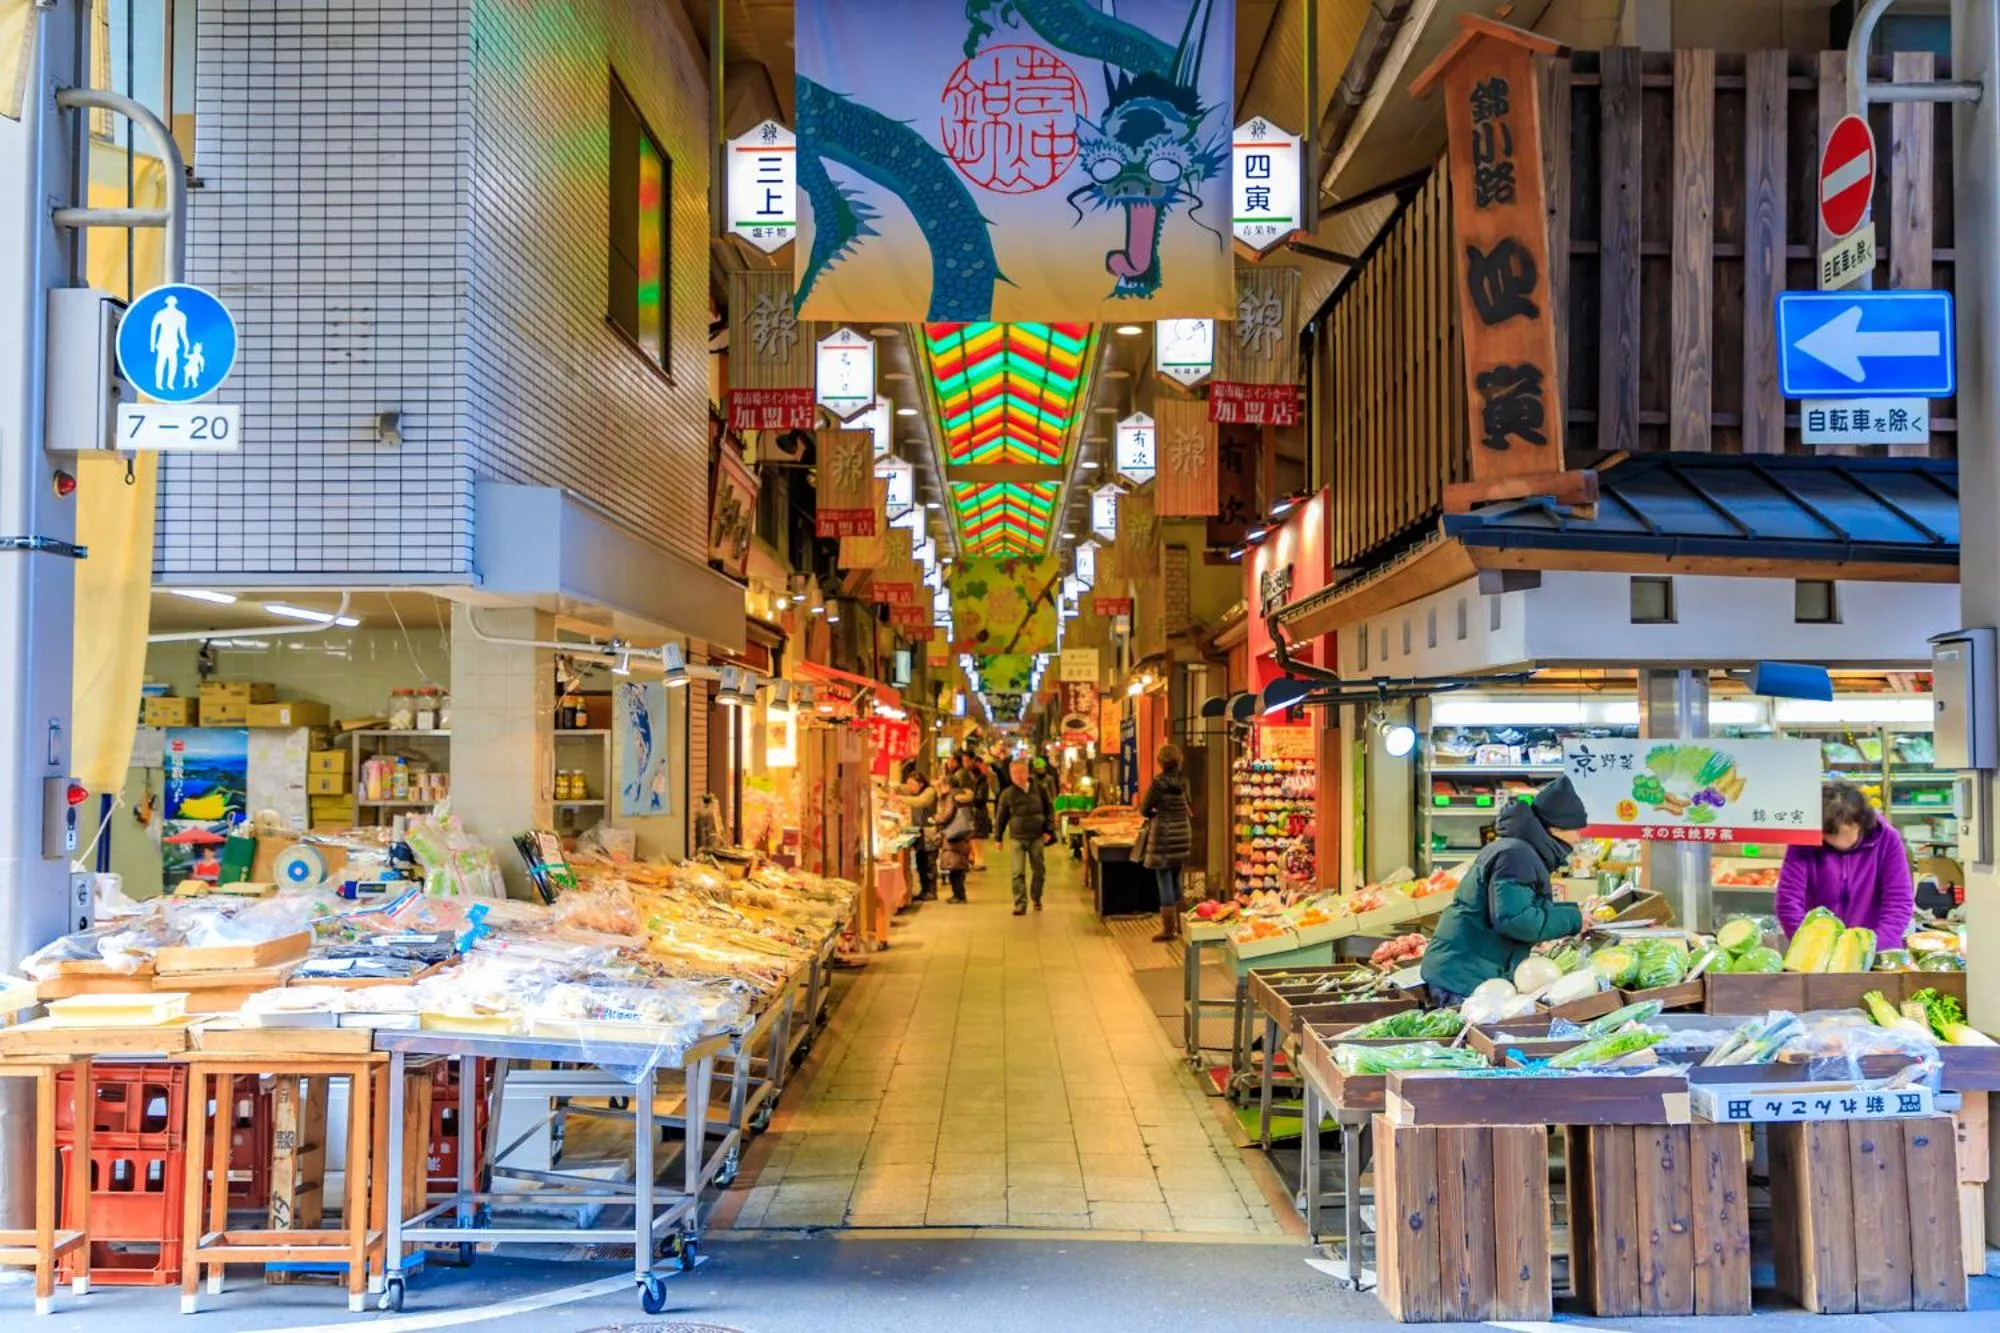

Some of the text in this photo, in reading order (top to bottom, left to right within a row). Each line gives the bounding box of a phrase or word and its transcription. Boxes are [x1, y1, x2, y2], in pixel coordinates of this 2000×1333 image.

[1470, 76, 1517, 208] 錦小路
[756, 157, 785, 215] 三上
[1245, 154, 1271, 212] 四寅
[1465, 235, 1549, 452] 四寅
[733, 405, 812, 429] 加盟店
[1214, 401, 1294, 425] 加盟店
[1808, 408, 1923, 433] 自転車を除く
[1132, 429, 1148, 465] 有次
[1568, 744, 1635, 778] 京野菜
[1641, 826, 1734, 841] 京の伝統野菜
[1765, 1095, 1886, 1116] 新れんこん
